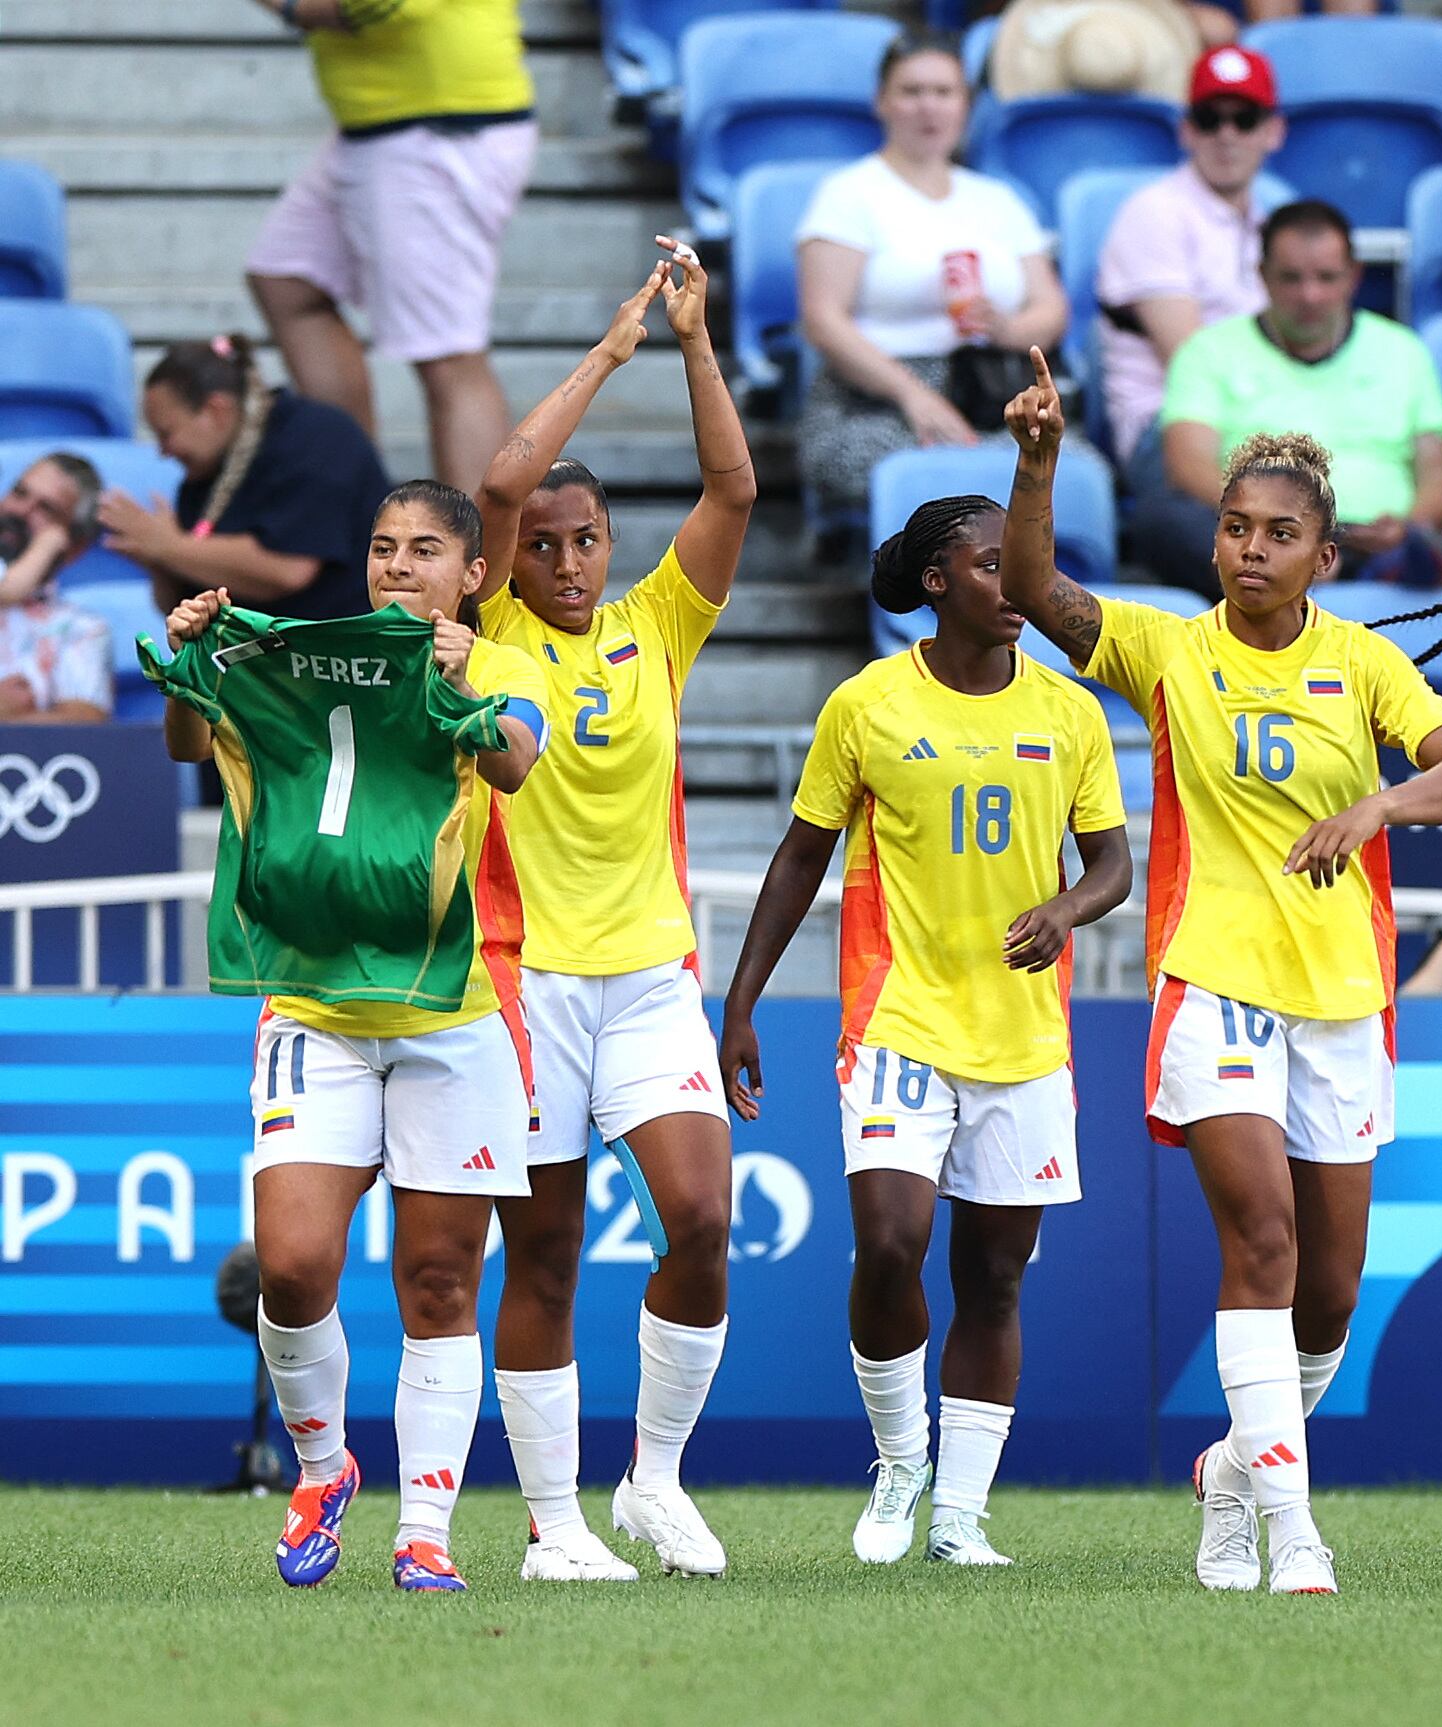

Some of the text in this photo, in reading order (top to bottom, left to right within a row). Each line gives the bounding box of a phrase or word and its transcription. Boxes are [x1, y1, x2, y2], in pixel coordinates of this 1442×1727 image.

[290, 652, 391, 687] PEREZ
[573, 687, 610, 746] 2
[1234, 713, 1294, 782] 16
[317, 704, 355, 837] 1
[951, 784, 1012, 855] 18
[267, 1032, 306, 1101] 11
[871, 1047, 932, 1111] 18
